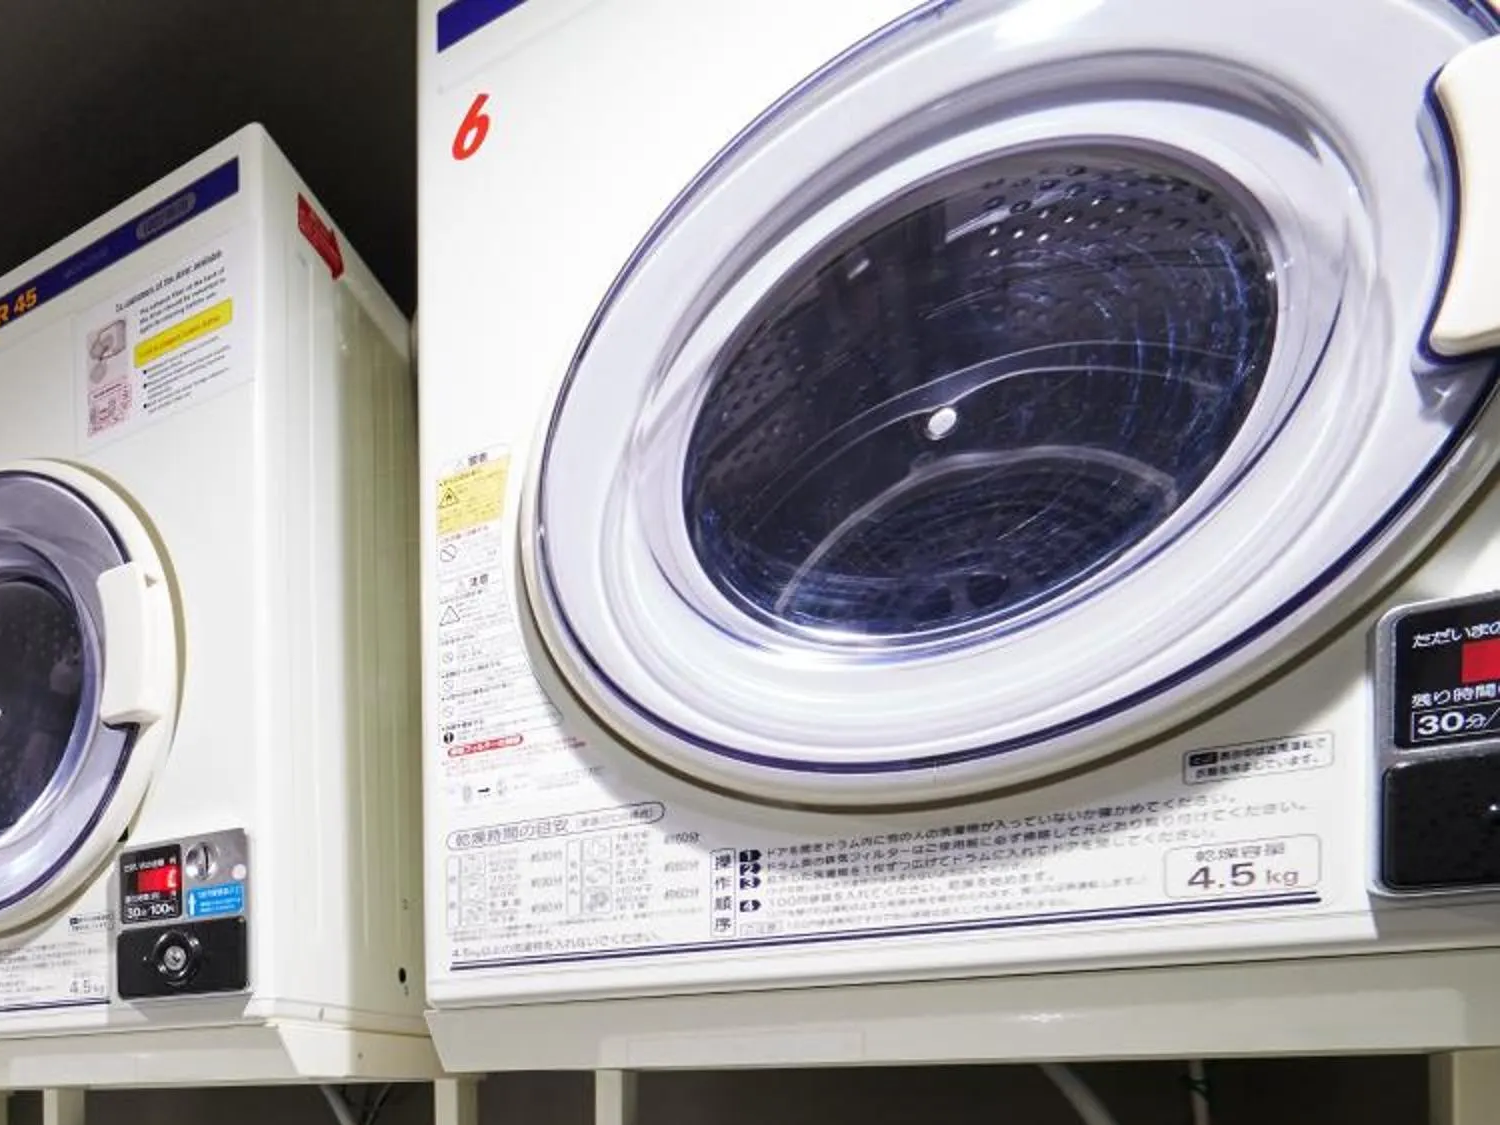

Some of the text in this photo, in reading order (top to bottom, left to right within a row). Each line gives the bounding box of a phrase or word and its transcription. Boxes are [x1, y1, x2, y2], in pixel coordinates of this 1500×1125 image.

[452, 93, 490, 161] 6
[14, 287, 38, 316] 45
[1188, 863, 1299, 889] 4.5 kg
